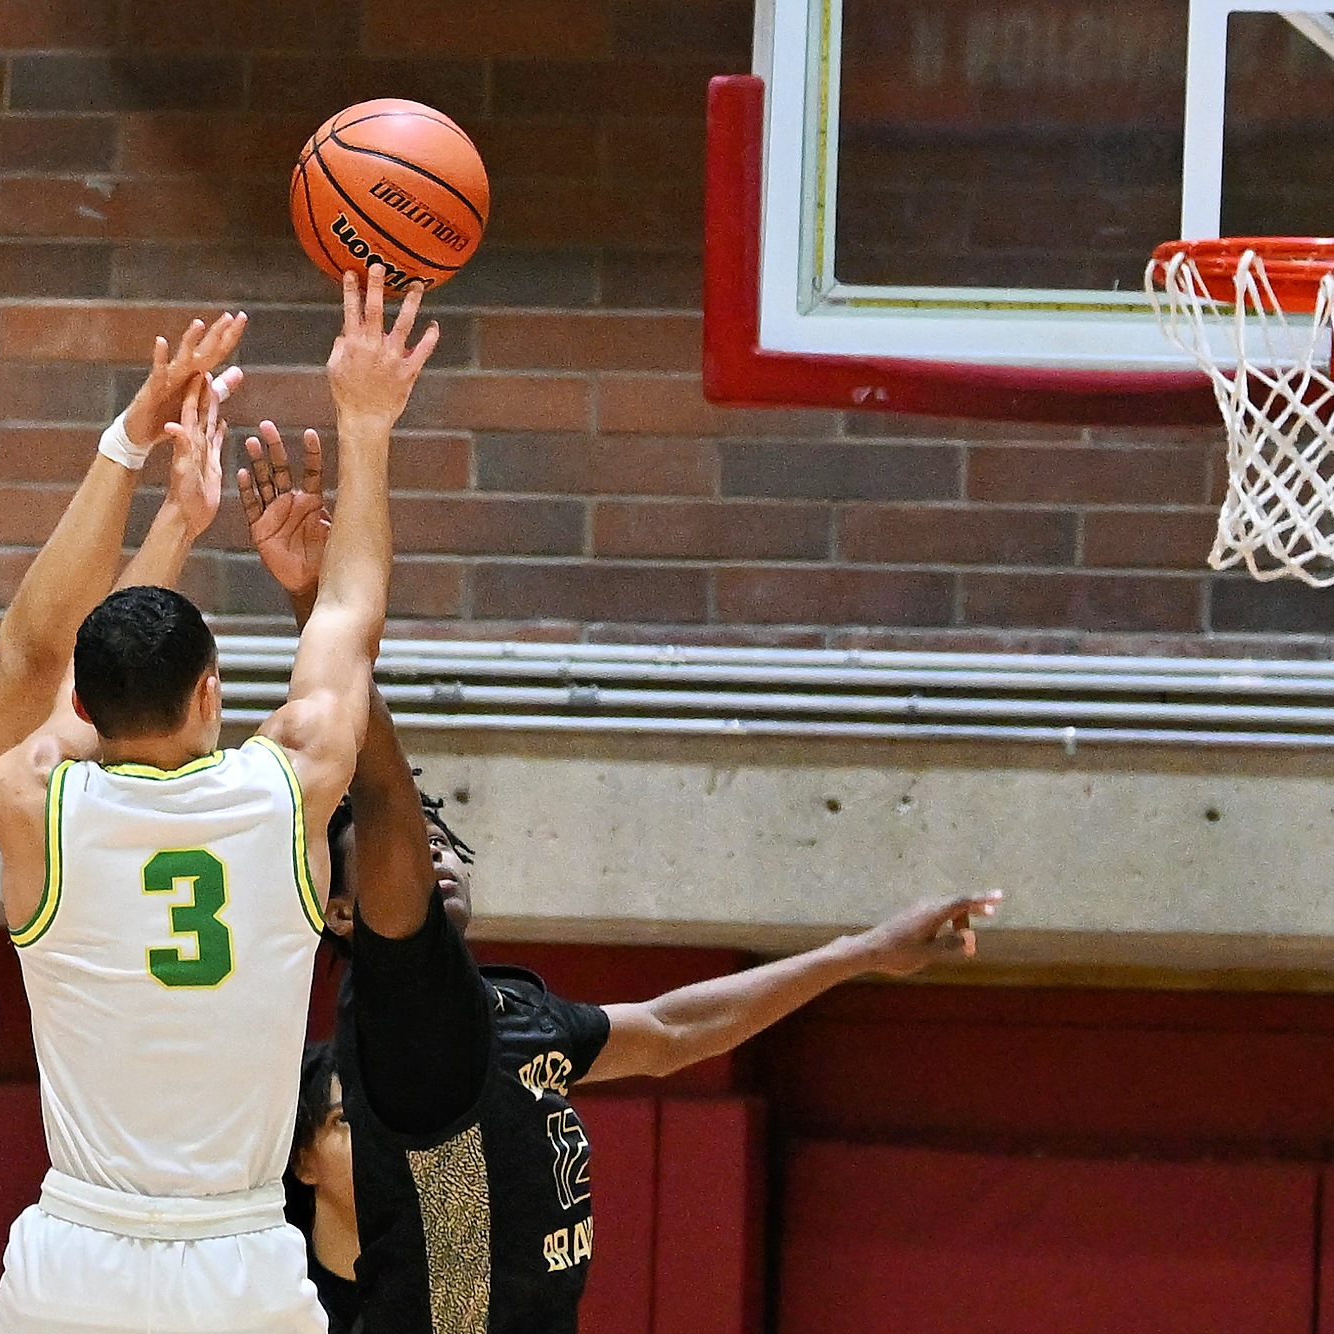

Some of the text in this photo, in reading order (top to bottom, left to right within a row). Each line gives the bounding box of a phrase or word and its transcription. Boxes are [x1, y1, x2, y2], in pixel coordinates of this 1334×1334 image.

[368, 182, 470, 252] EVOLUTION
[140, 846, 236, 990] 3
[546, 1107, 591, 1210] 12
